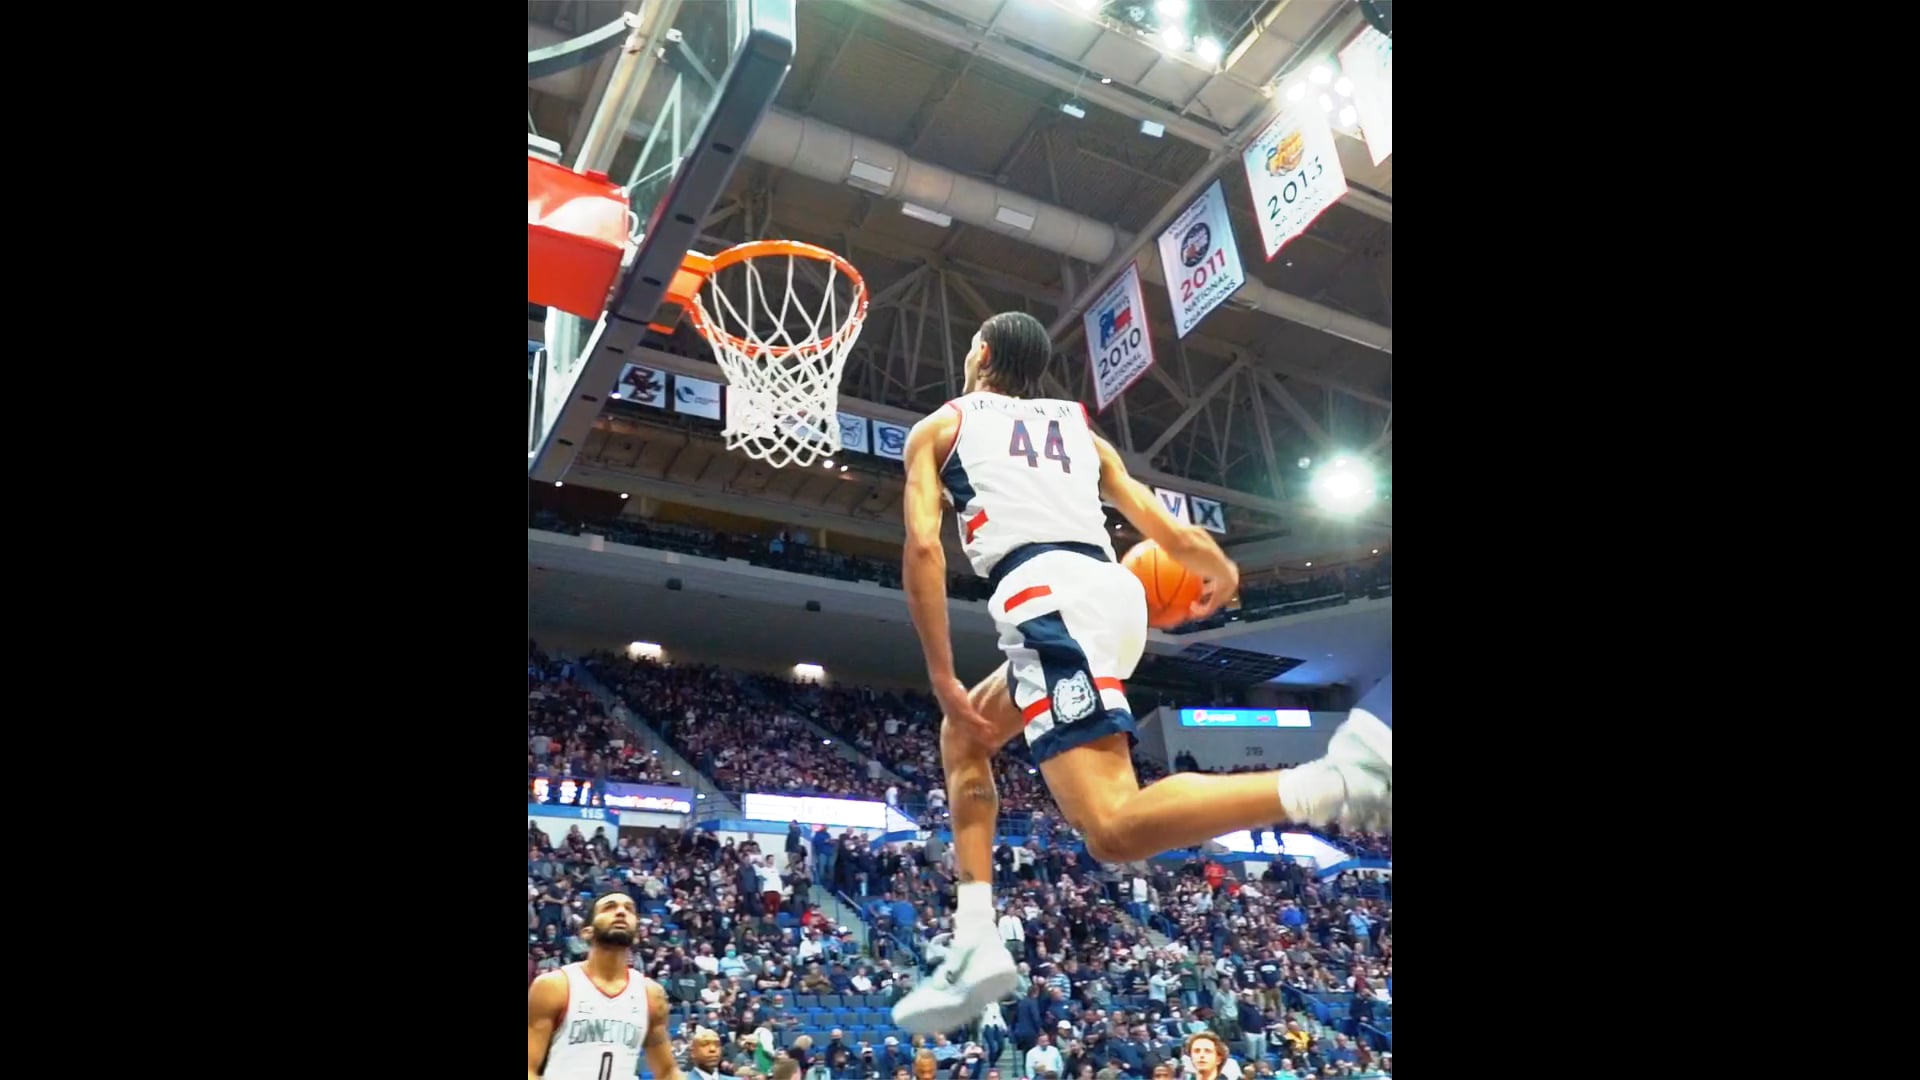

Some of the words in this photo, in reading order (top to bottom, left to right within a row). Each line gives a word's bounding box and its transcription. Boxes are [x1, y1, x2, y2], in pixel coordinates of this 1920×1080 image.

[1180, 247, 1227, 303] 2011
[1183, 272, 1229, 315] NATIONAL
[1183, 279, 1237, 330] CHAMPIONS
[1098, 327, 1141, 380] 2010
[1009, 419, 1072, 474] 44
